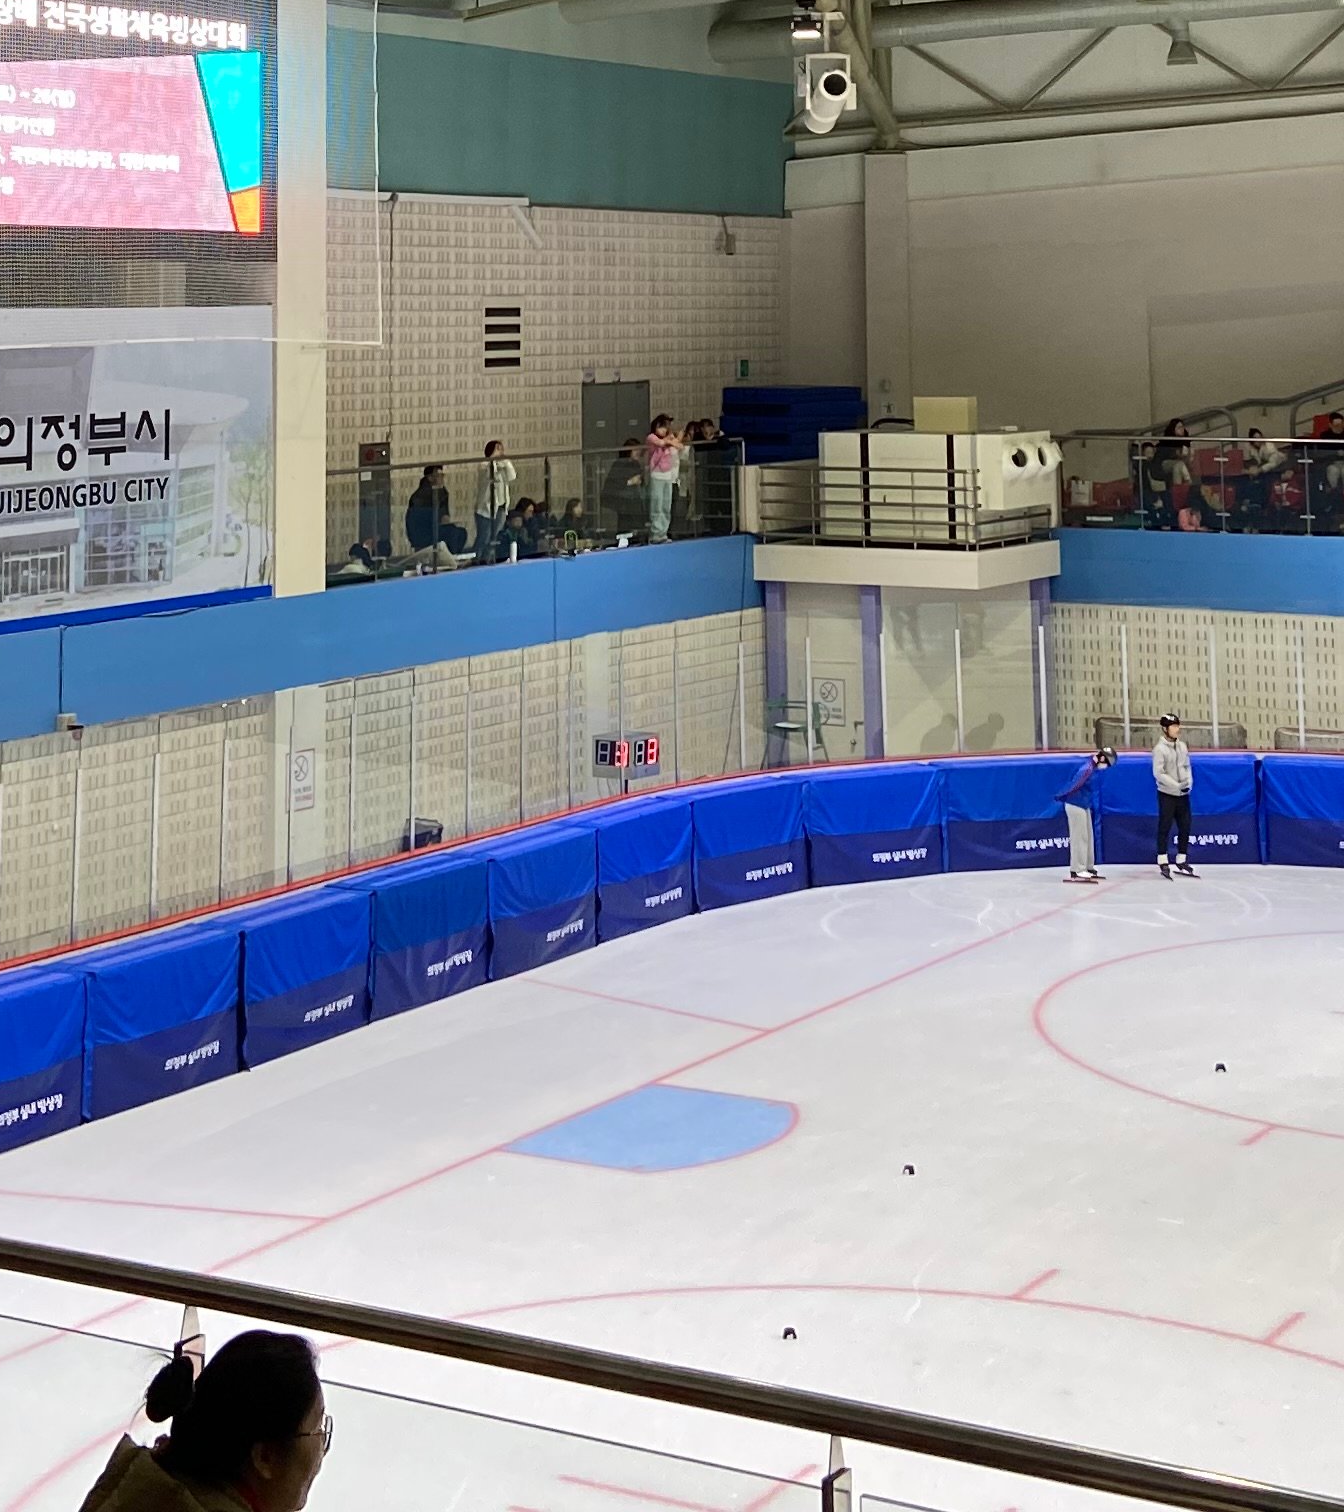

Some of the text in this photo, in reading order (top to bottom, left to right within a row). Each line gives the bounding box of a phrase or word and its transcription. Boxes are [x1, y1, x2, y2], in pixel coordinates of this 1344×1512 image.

[43, 0, 248, 51] 전국생활체육빙상대회
[124, 476, 170, 503] CITY
[1054, 837, 1070, 848] 빙상
[20, 1103, 36, 1120] 실내
[36, 1093, 63, 1113] 빙상장
